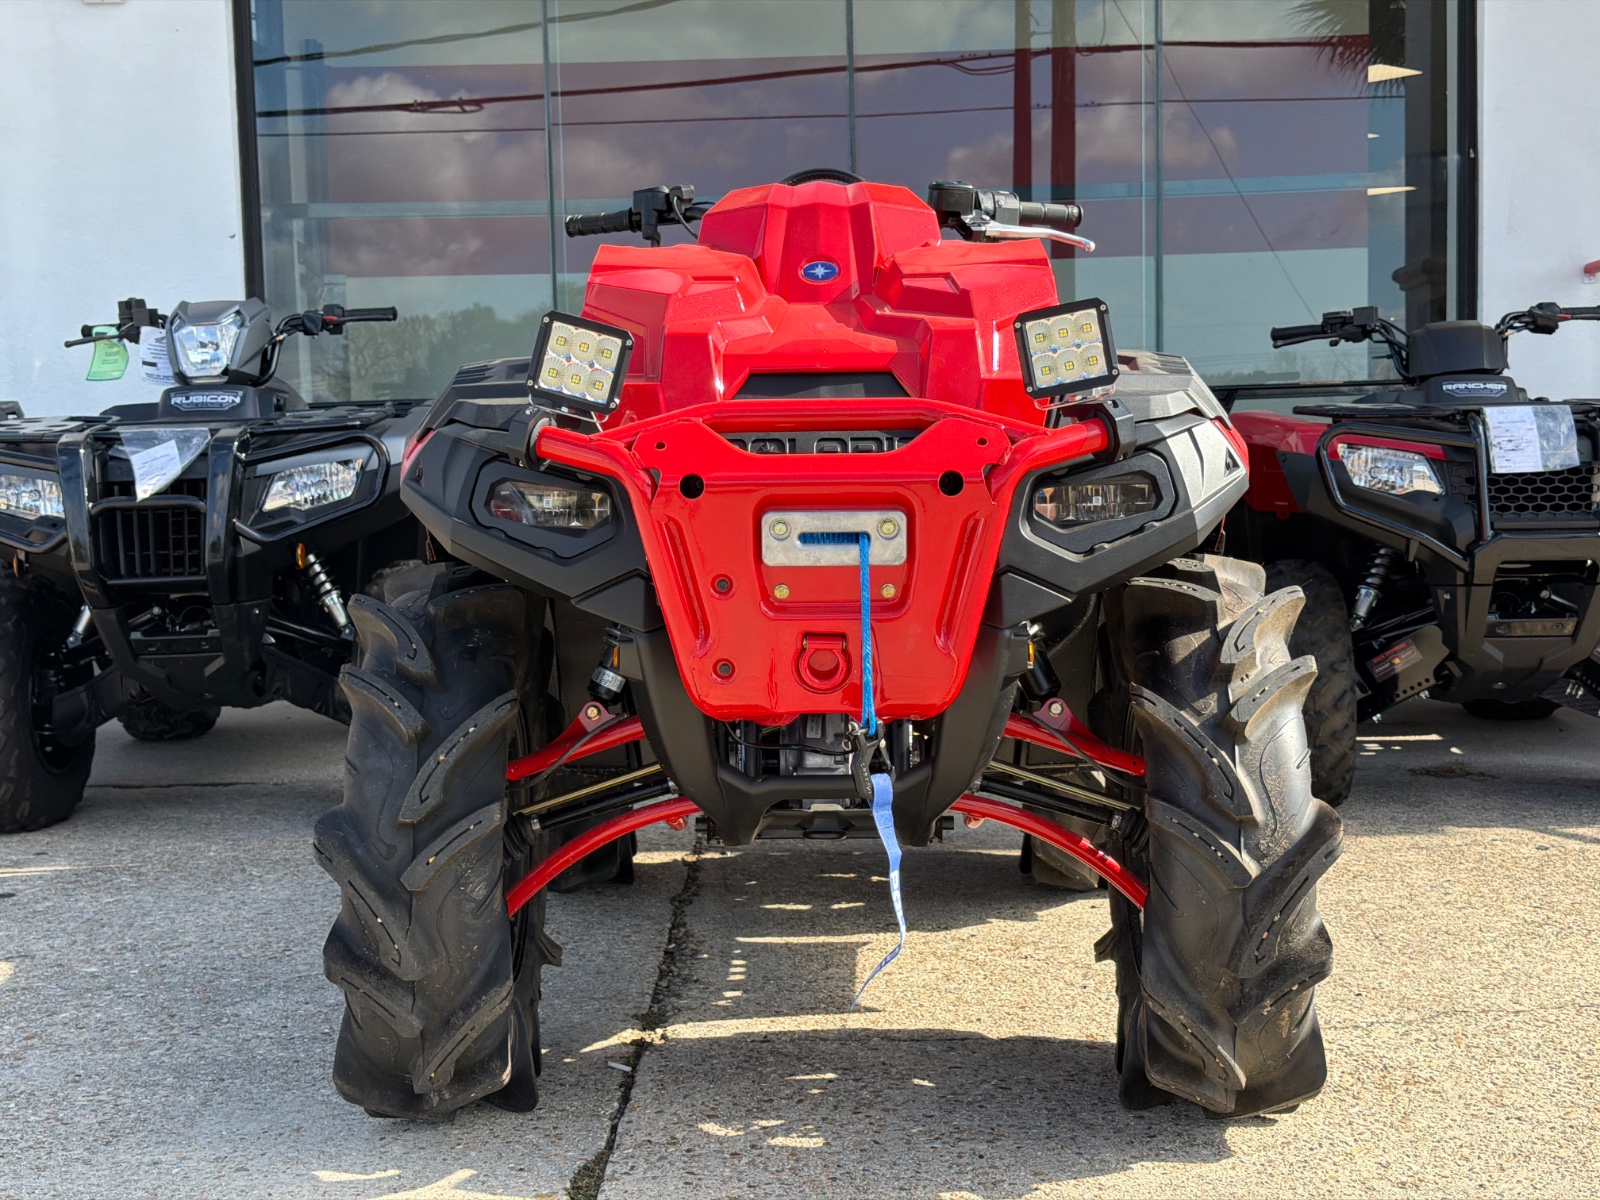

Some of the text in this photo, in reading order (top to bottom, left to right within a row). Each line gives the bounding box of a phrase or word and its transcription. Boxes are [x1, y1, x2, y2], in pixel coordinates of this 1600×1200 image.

[1442, 383, 1507, 391] RANCHER
[170, 395, 241, 405] RUBICON
[726, 436, 917, 454] OLARI
